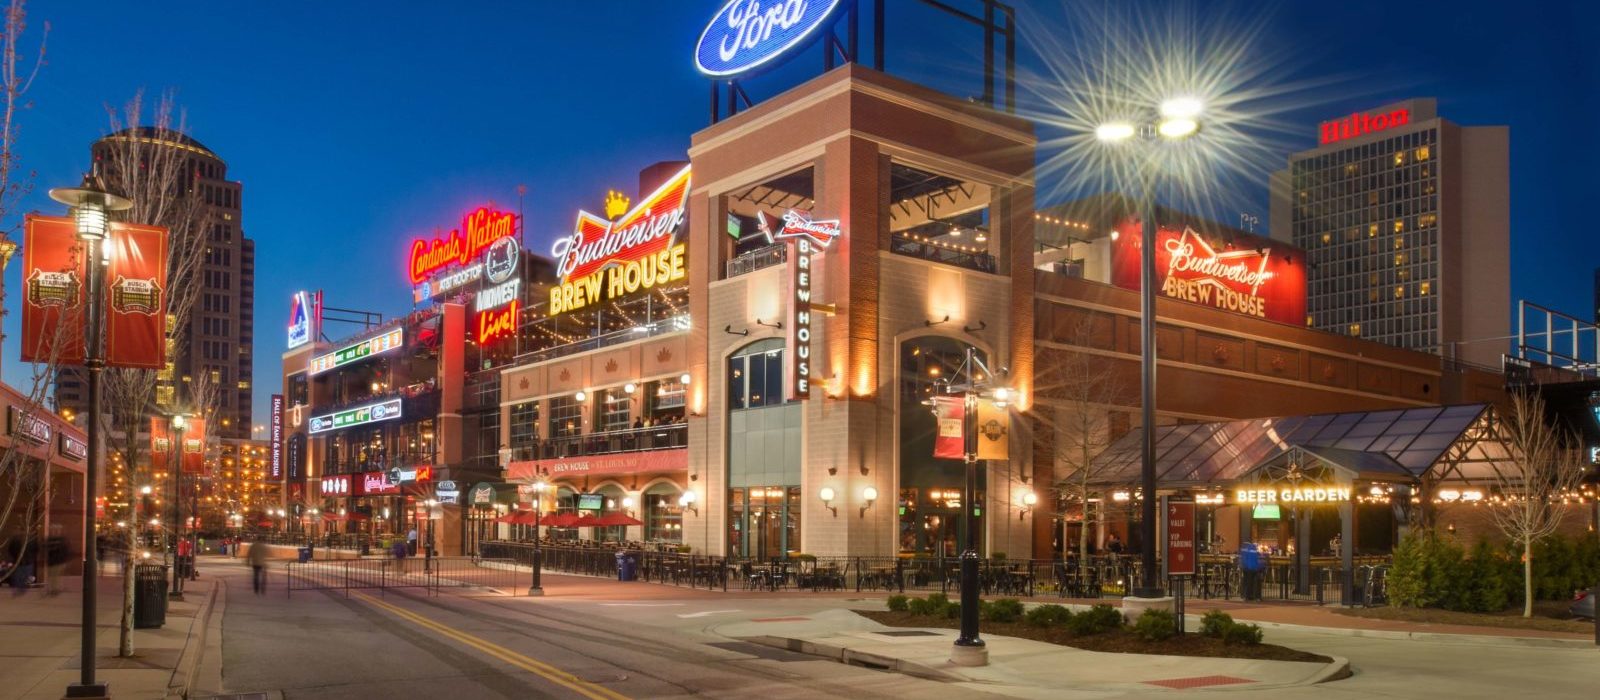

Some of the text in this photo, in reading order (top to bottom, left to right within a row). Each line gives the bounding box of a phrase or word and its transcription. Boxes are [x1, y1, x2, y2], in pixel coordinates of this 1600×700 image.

[719, 0, 808, 62] Ford
[1320, 108, 1409, 145] Hilton
[410, 207, 512, 283] Cardinals Nation
[551, 207, 685, 278] Budweiser
[783, 212, 841, 237] Budweiser
[549, 243, 686, 317] BREW HOUSE
[1165, 238, 1273, 286] Budweiser
[476, 278, 520, 312] MIDWEST
[797, 239, 810, 393] BREW HOUSE
[1166, 276, 1265, 318] BREW HOUSE
[479, 300, 518, 344] Live!
[570, 461, 589, 471] HOUSE
[1237, 488, 1351, 503] BEER GARDEN
[1170, 519, 1186, 527] VALET
[1170, 540, 1193, 548] PARKING
